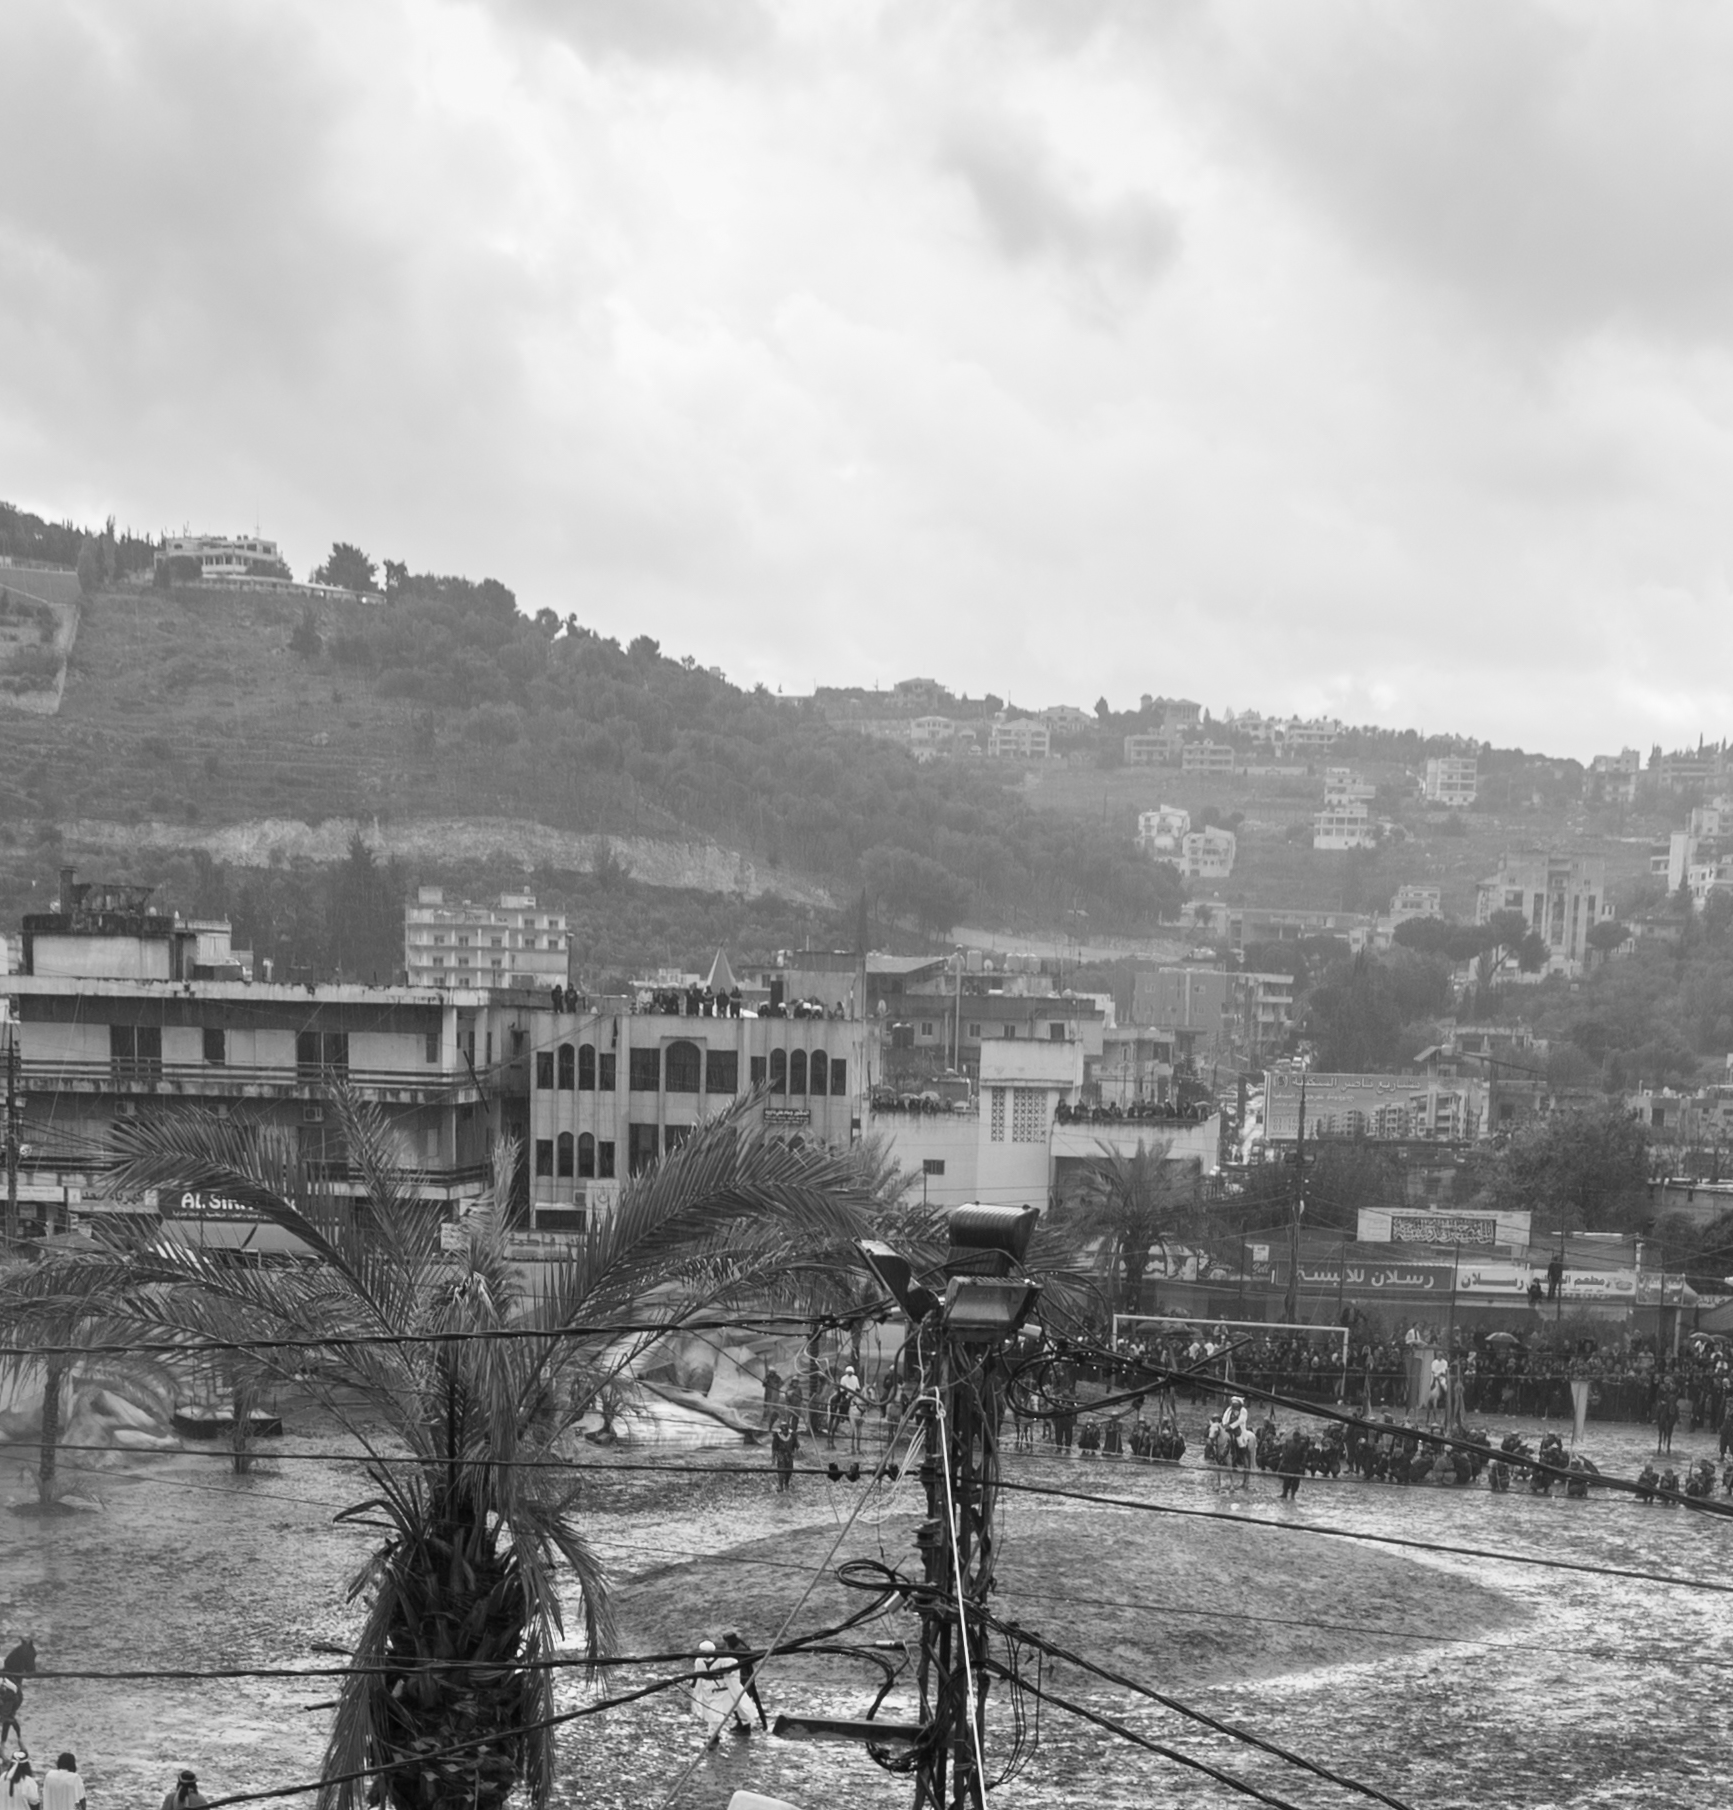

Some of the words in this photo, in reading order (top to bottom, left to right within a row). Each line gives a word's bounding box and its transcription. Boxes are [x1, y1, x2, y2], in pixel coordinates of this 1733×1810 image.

[1340, 1077, 1374, 1092] ناصر
[1377, 1078, 1421, 1095] مشاريع
[1371, 1268, 1434, 1289] رسلان
[1460, 1272, 1524, 1290] رسلان
[1574, 1275, 1605, 1287] مطعم
